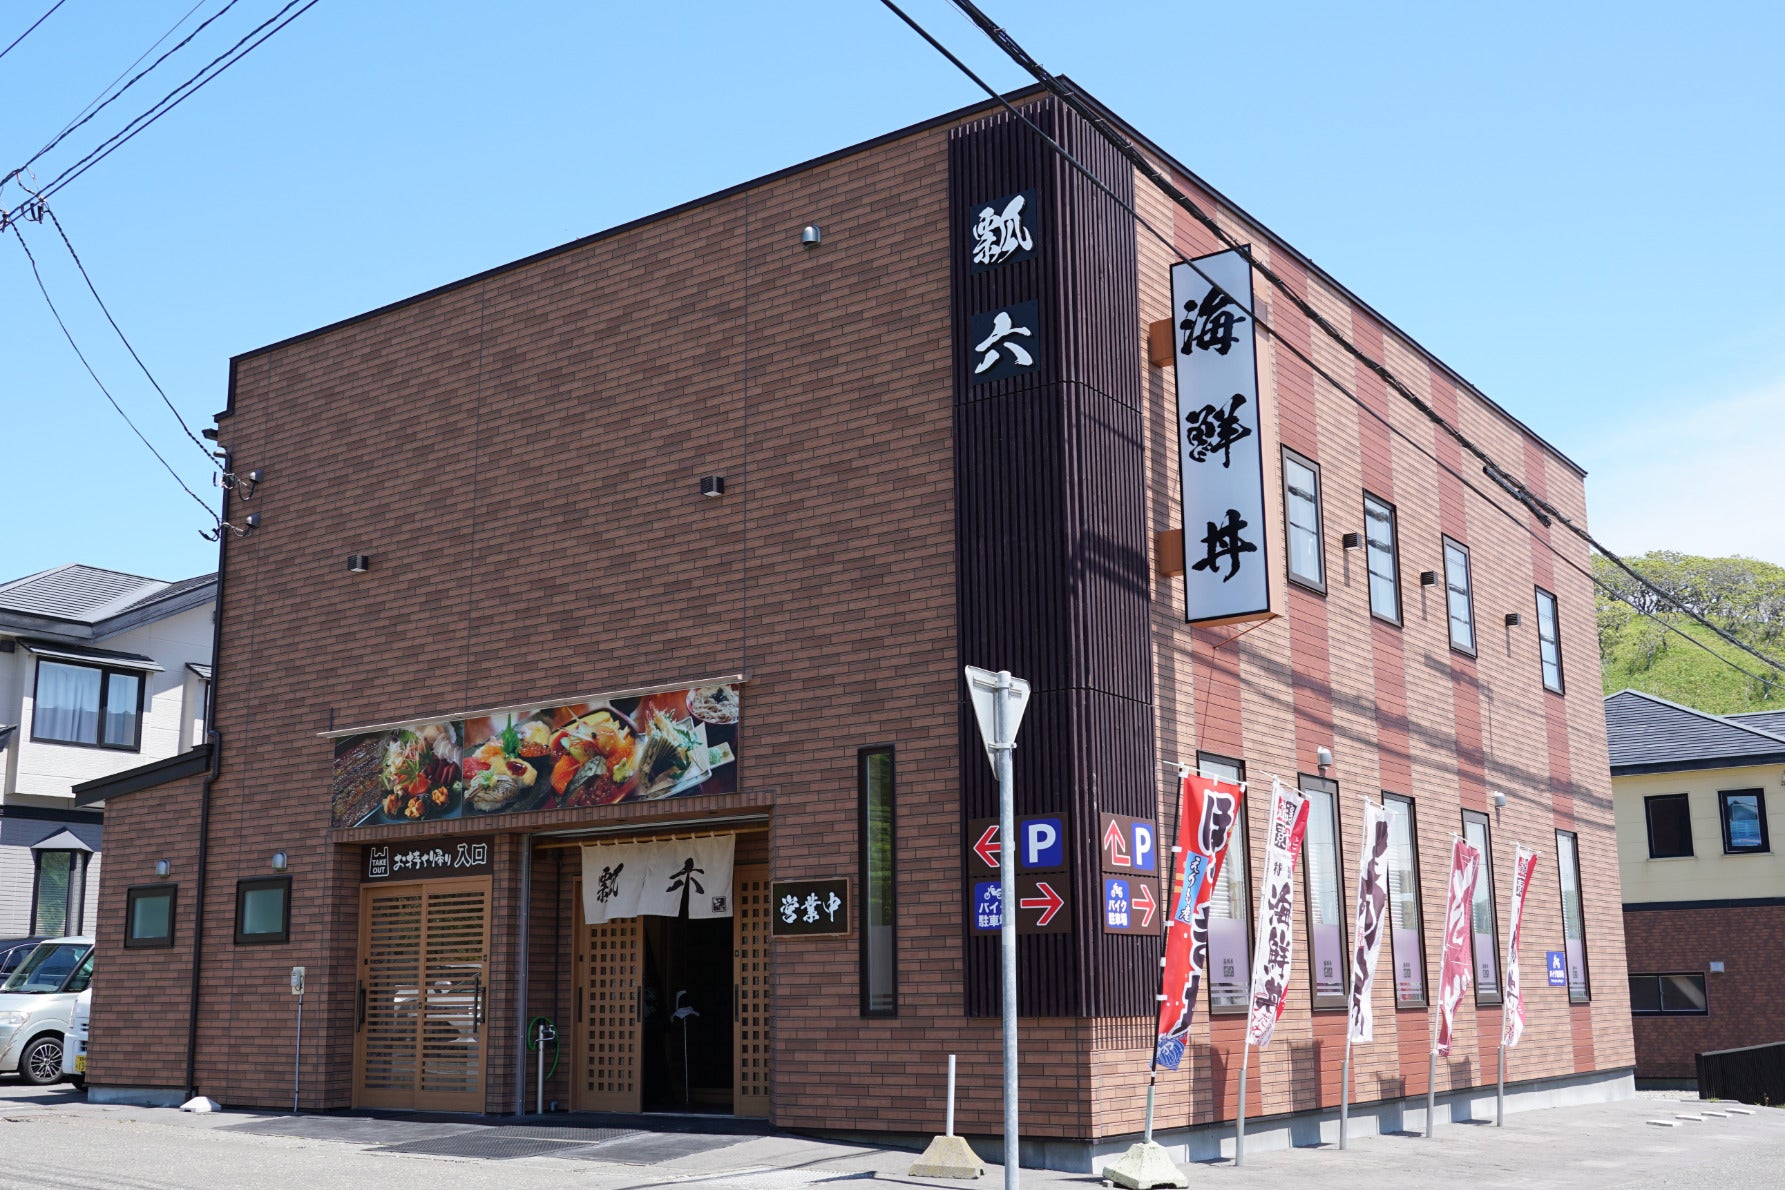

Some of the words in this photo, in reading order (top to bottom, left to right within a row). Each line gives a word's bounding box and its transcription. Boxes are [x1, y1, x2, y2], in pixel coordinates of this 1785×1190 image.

[1180, 286, 1258, 583] 海鮮丼
[454, 843, 488, 868] 入口
[1029, 823, 1056, 863] P
[1135, 827, 1151, 865] P
[372, 859, 387, 867] TAKE
[780, 891, 842, 923] 営業中
[979, 902, 1002, 914] バイ
[1108, 899, 1127, 912] バイク
[979, 914, 1002, 928] 駐車
[1256, 881, 1292, 1013] 海鮮丼
